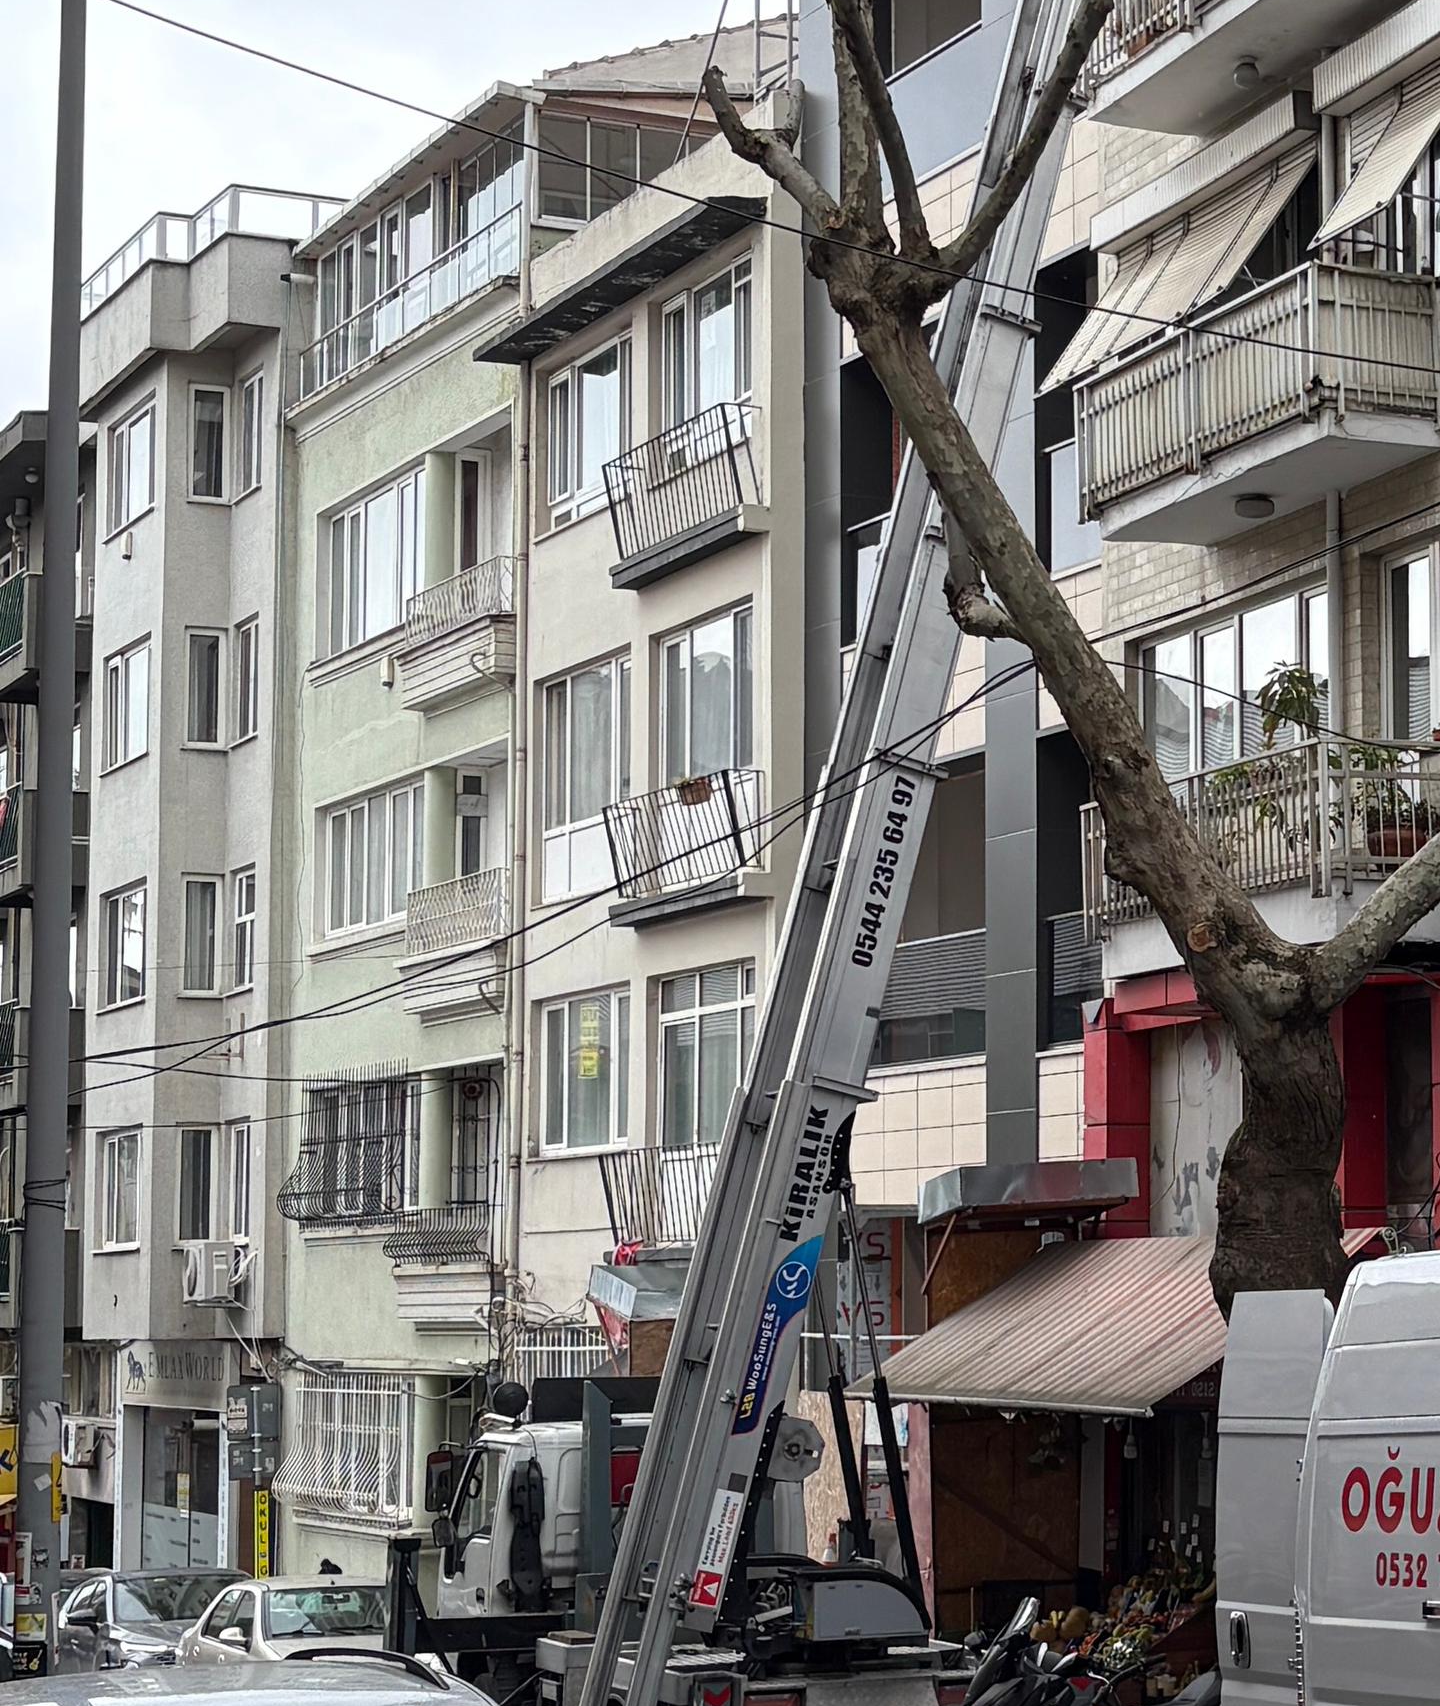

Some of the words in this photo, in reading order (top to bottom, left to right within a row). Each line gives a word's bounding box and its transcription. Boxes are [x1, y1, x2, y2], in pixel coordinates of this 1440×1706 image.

[891, 775, 916, 807] 97
[883, 810, 908, 844] 64
[869, 848, 899, 900] 235
[852, 901, 886, 967] 0544
[259, 1493, 268, 1544] OKUL
[1376, 1552, 1428, 1588] 0532
